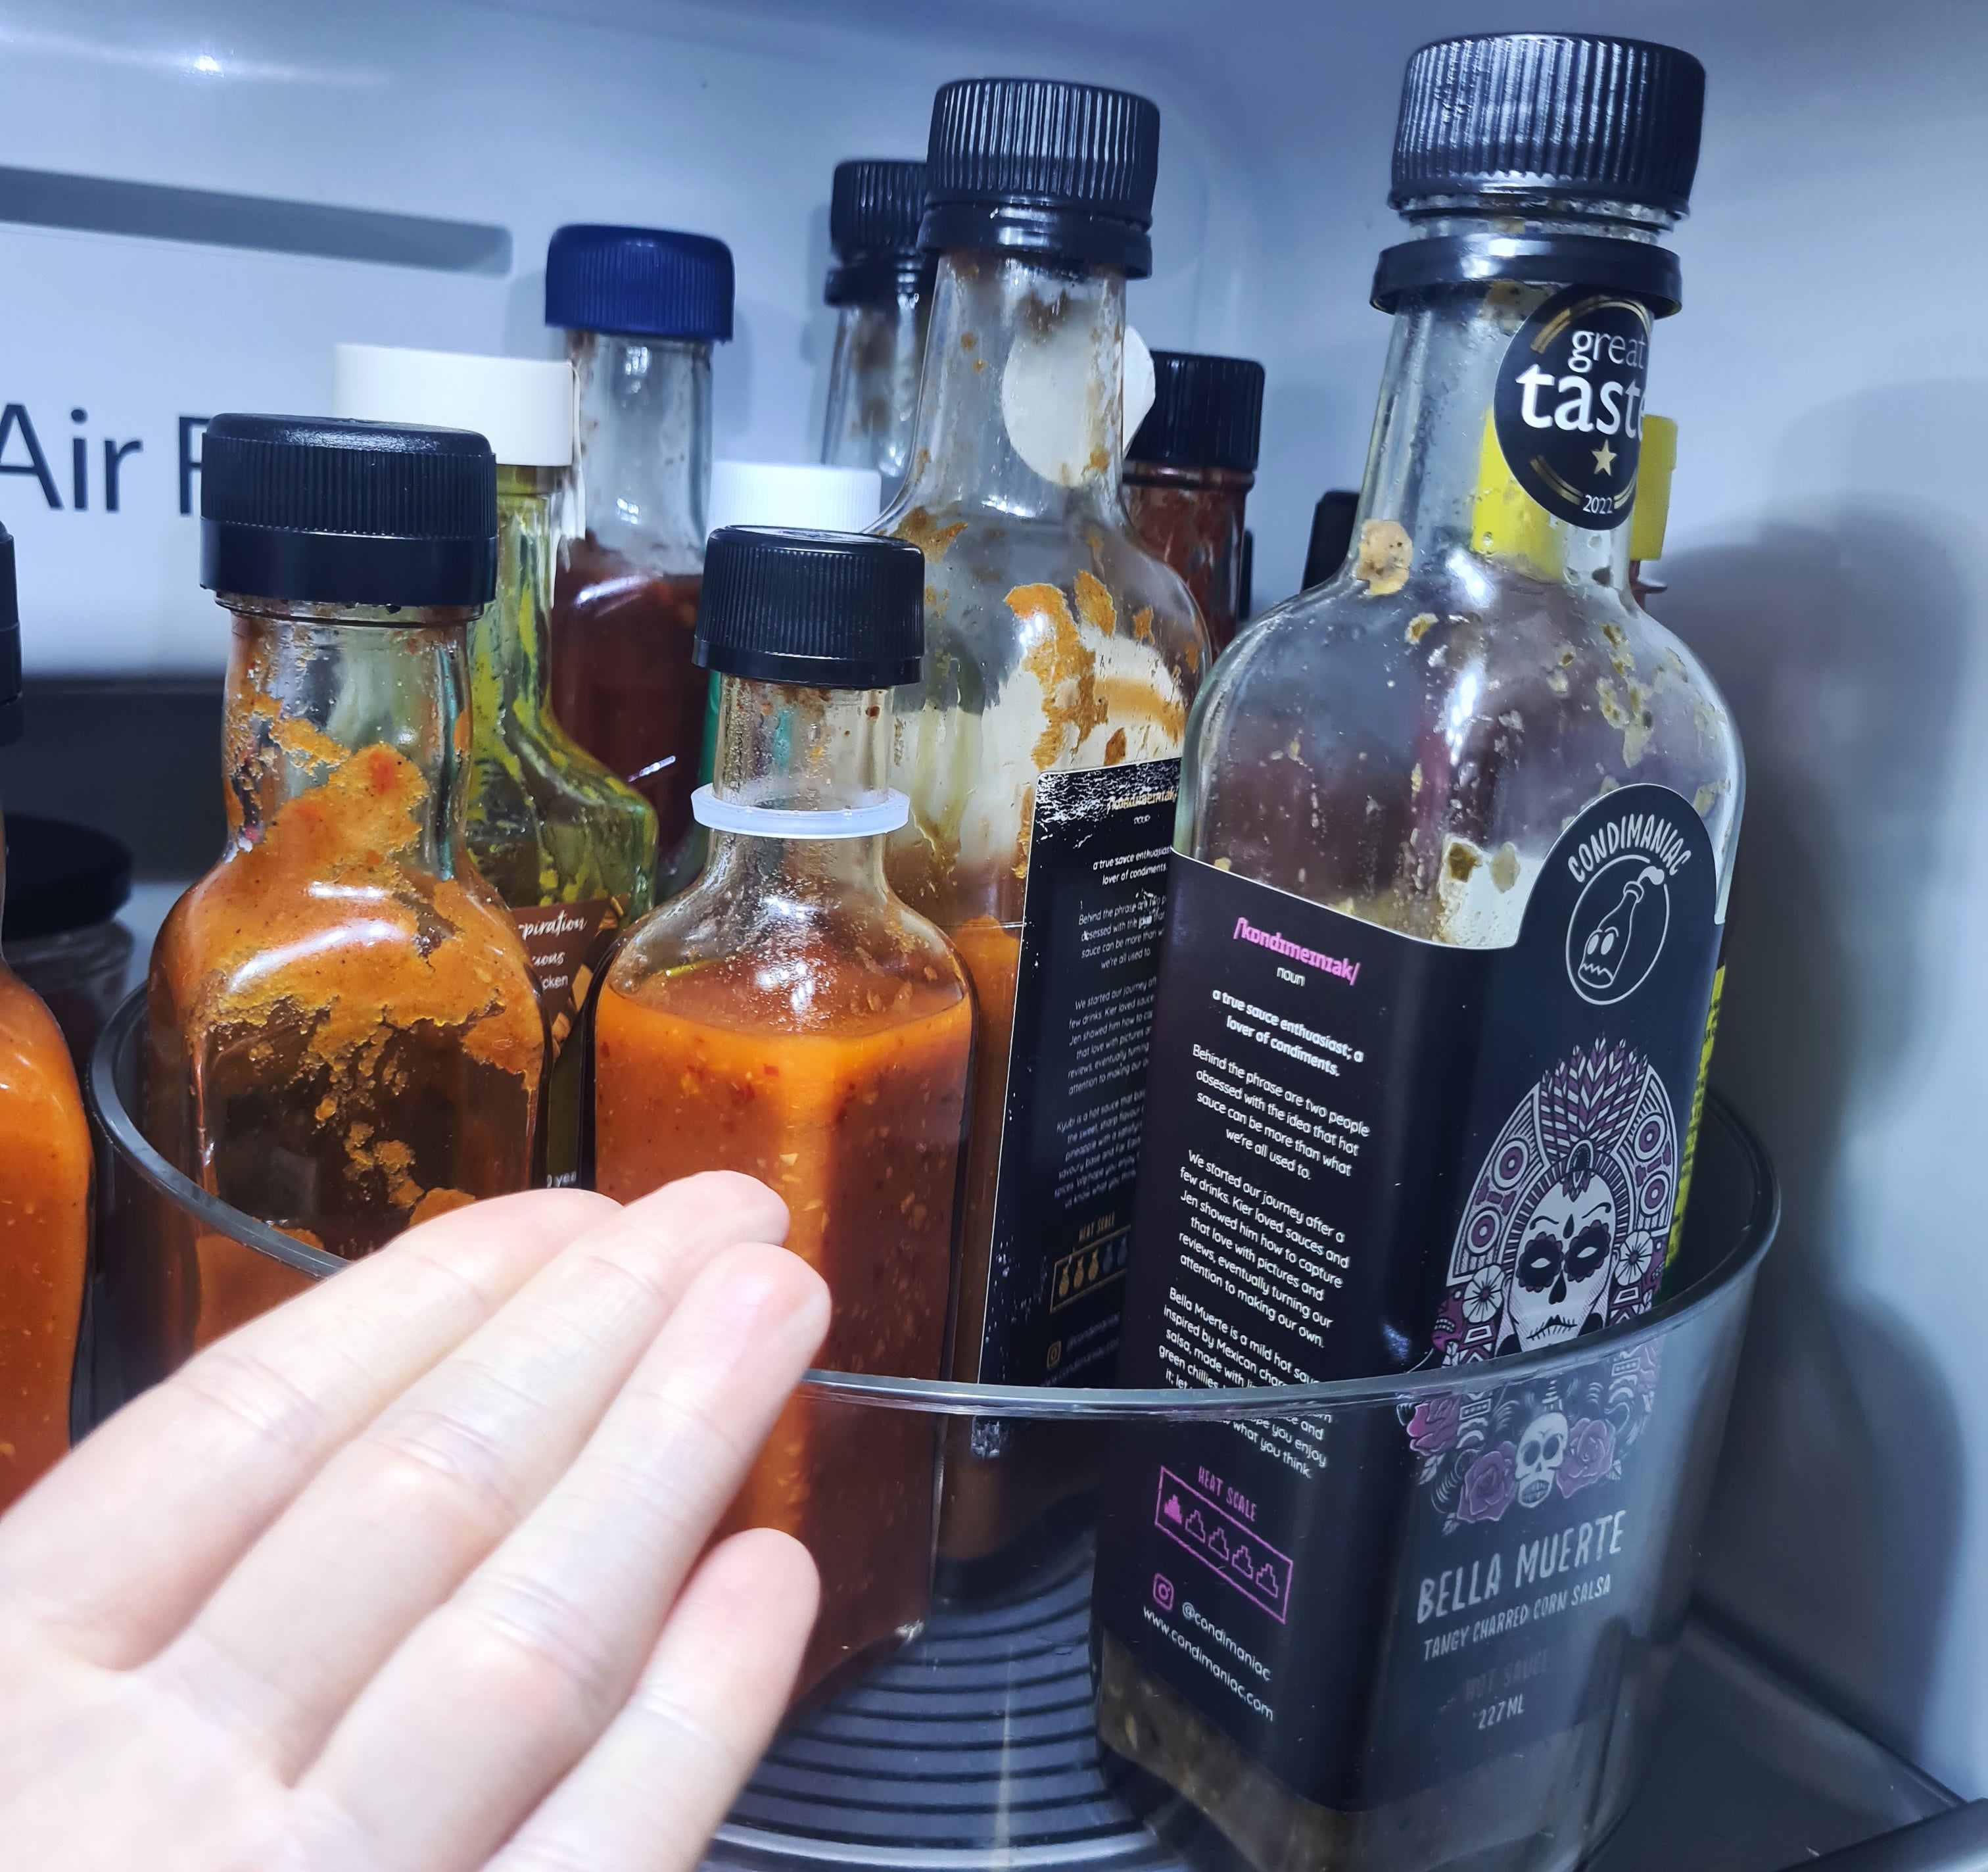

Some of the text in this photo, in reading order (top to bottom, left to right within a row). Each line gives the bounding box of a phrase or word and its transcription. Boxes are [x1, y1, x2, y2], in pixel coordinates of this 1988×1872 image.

[1567, 330, 1646, 373] great
[0, 404, 64, 512] Air
[1583, 494, 1613, 514] 2022
[1100, 853, 1133, 869] true sauce
[1568, 813, 1691, 882] CONDIMANIAC
[1102, 874, 1119, 886] lover
[1121, 869, 1129, 880] of
[518, 909, 588, 940] piration
[1079, 903, 1136, 926] Behind the phrase
[1113, 921, 1125, 932] with
[532, 951, 565, 967] ious
[1081, 930, 1156, 959] sauce can be more than
[1100, 957, 1118, 969] we're
[1128, 949, 1143, 961] used
[1075, 1000, 1085, 1011] We
[1087, 990, 1110, 1007] started
[1111, 988, 1123, 998] our
[1123, 981, 1147, 997] journey
[1277, 967, 1305, 986] noun
[1069, 999, 1135, 1030] few Kier loved
[1069, 1035, 1082, 1046] Jen
[1083, 1024, 1107, 1042] showed
[1108, 1021, 1122, 1034] him
[1122, 1017, 1135, 1028] how
[1136, 1013, 1143, 1023] to
[1212, 990, 1364, 1063] a true sauce enthusiast; a
[1076, 1047, 1090, 1060] that
[1091, 1043, 1104, 1054] love
[1120, 1027, 1144, 1045] pictures
[1095, 1049, 1127, 1070] eventually
[1226, 1015, 1341, 1077] lover of condiments.
[1068, 1077, 1098, 1096] attention
[1193, 1044, 1370, 1138] Behind the phrase are two people
[1196, 1069, 1360, 1157] obsessed with the idea that hot
[1196, 1091, 1353, 1177] sauce can be more than what
[1226, 1128, 1312, 1180] we're all used to.
[1180, 1166, 1350, 1269] few drinks. Kier loved sauces and
[1189, 1149, 1346, 1243] We started our journey after a
[1180, 1189, 1344, 1289] Jen showed him how to capture
[1191, 1216, 1325, 1302] that love with pictures and
[1179, 1232, 1335, 1329] reviews, eventually turning our
[1180, 1254, 1325, 1349] attention to making our own.
[1164, 1304, 1289, 1387] inspired by Mexican char
[1170, 1287, 1321, 1383] Bella Muerte is a mild hot sau
[1158, 1345, 1185, 1370] green
[1187, 1362, 1219, 1389] chillies
[1175, 1374, 1188, 1389] let
[1194, 1347, 1222, 1373] made
[1225, 1367, 1244, 1387] with
[1233, 1421, 1259, 1443] what
[1260, 1437, 1280, 1457] you
[1272, 1424, 1327, 1468] you enjoy
[1300, 1420, 1324, 1441] and
[1197, 1465, 1257, 1522] HEAT SCALE
[1417, 1510, 1626, 1624] BELLA MUERTE
[1423, 1573, 1612, 1662] TANGY CHARRED CORN SALSA
[1143, 1606, 1274, 1722] www.condimaniac.com
[1182, 1601, 1272, 1683] @condimaniac
